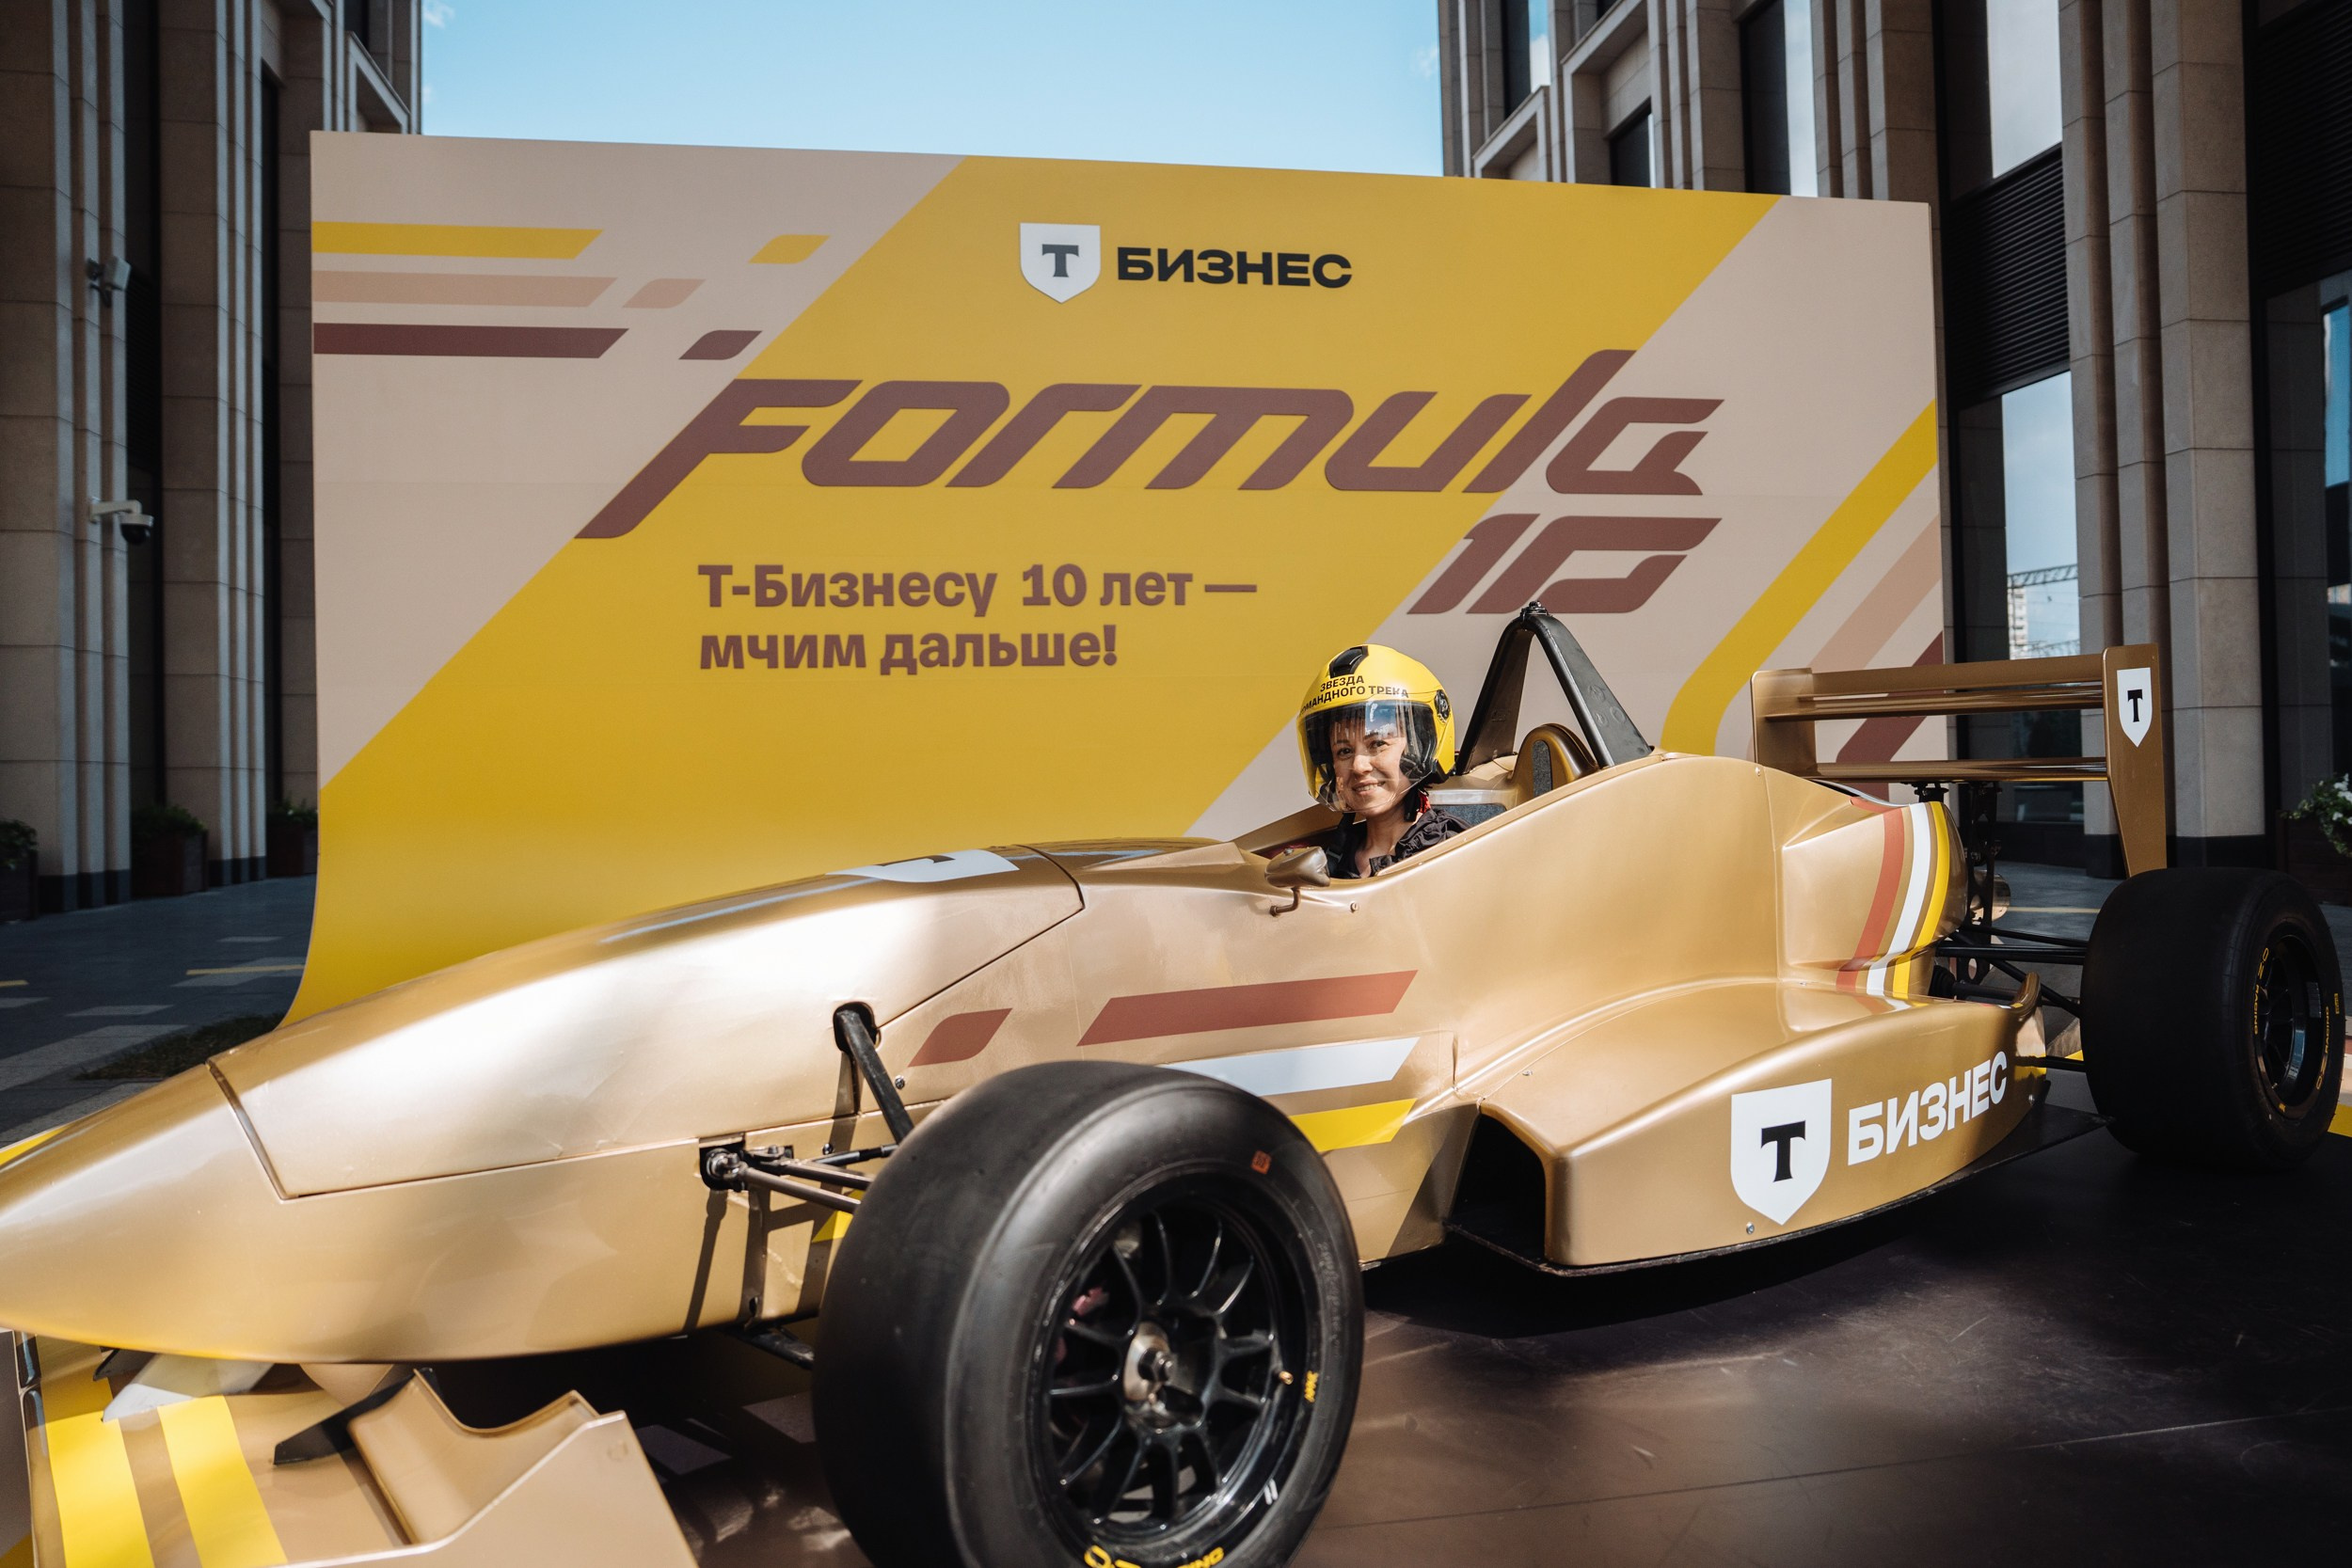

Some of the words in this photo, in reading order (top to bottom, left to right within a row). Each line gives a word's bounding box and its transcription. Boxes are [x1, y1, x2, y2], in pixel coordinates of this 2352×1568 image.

[1117, 246, 1352, 289] БИЗНЕС
[574, 349, 1724, 539] Formula
[697, 564, 997, 618] Т-Бизнесу
[1023, 563, 1087, 607] 10
[1100, 572, 1193, 607] лет
[700, 634, 866, 670] мчим
[880, 625, 1118, 676] дальше!
[1320, 675, 1364, 692] ЗВЕЗДА
[1369, 685, 1409, 698] ТРЕКА
[1847, 1051, 2008, 1166] БИЗНЕС
